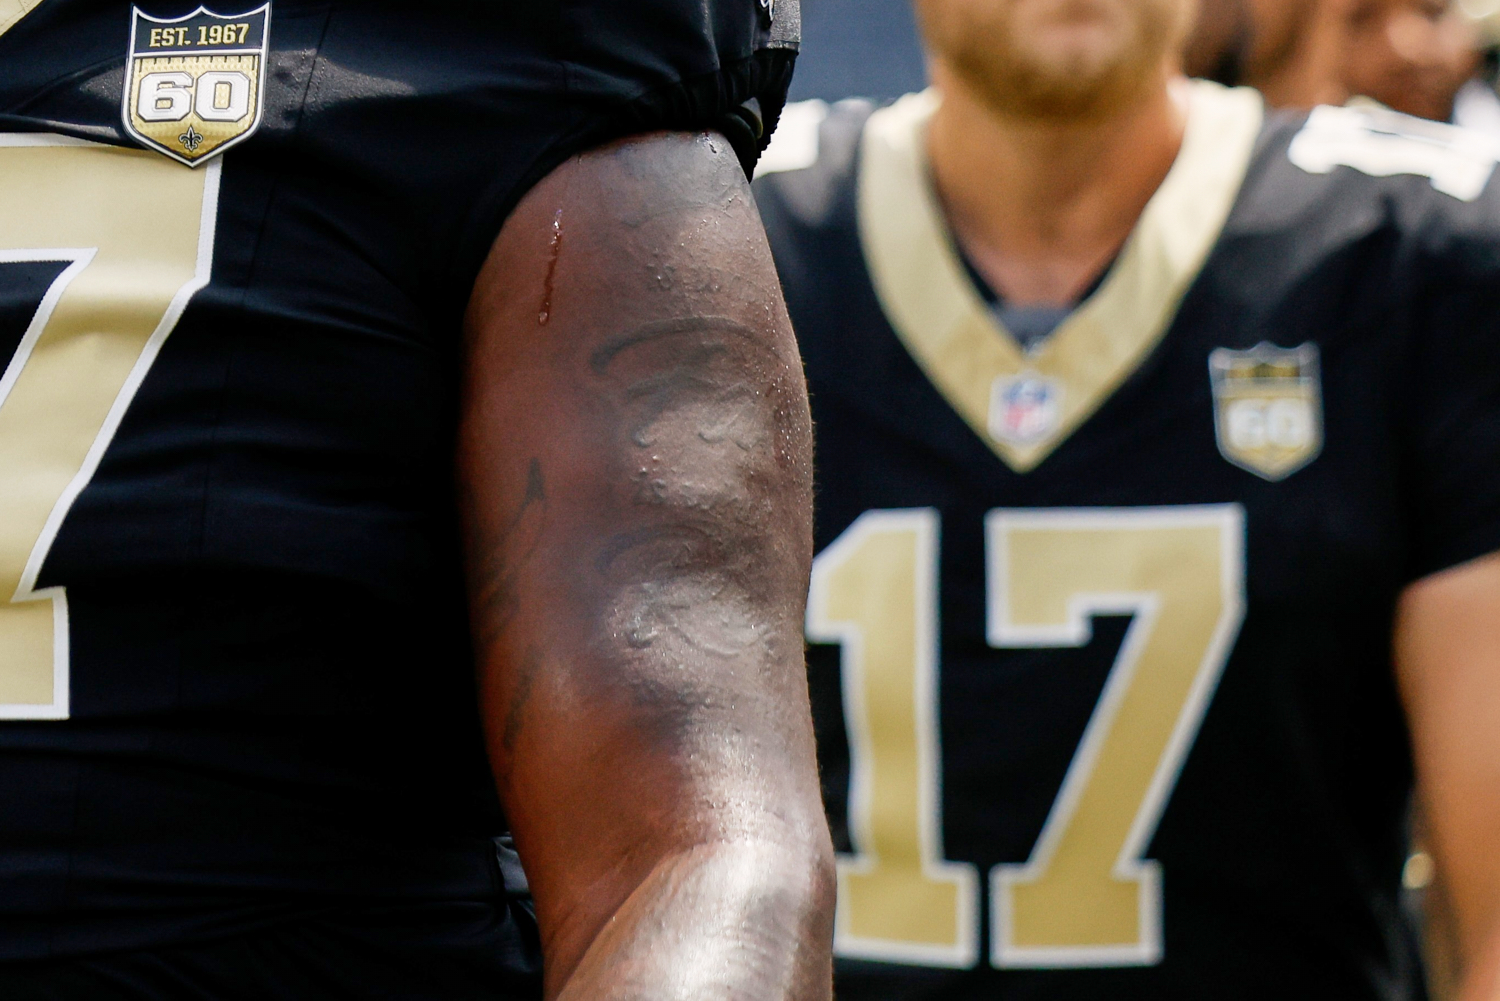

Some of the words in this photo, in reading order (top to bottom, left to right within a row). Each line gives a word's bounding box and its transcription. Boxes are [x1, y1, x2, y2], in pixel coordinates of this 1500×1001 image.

[149, 26, 192, 48] EST.
[196, 22, 251, 47] 1967
[137, 70, 252, 123] 60
[804, 502, 1247, 970] 17
